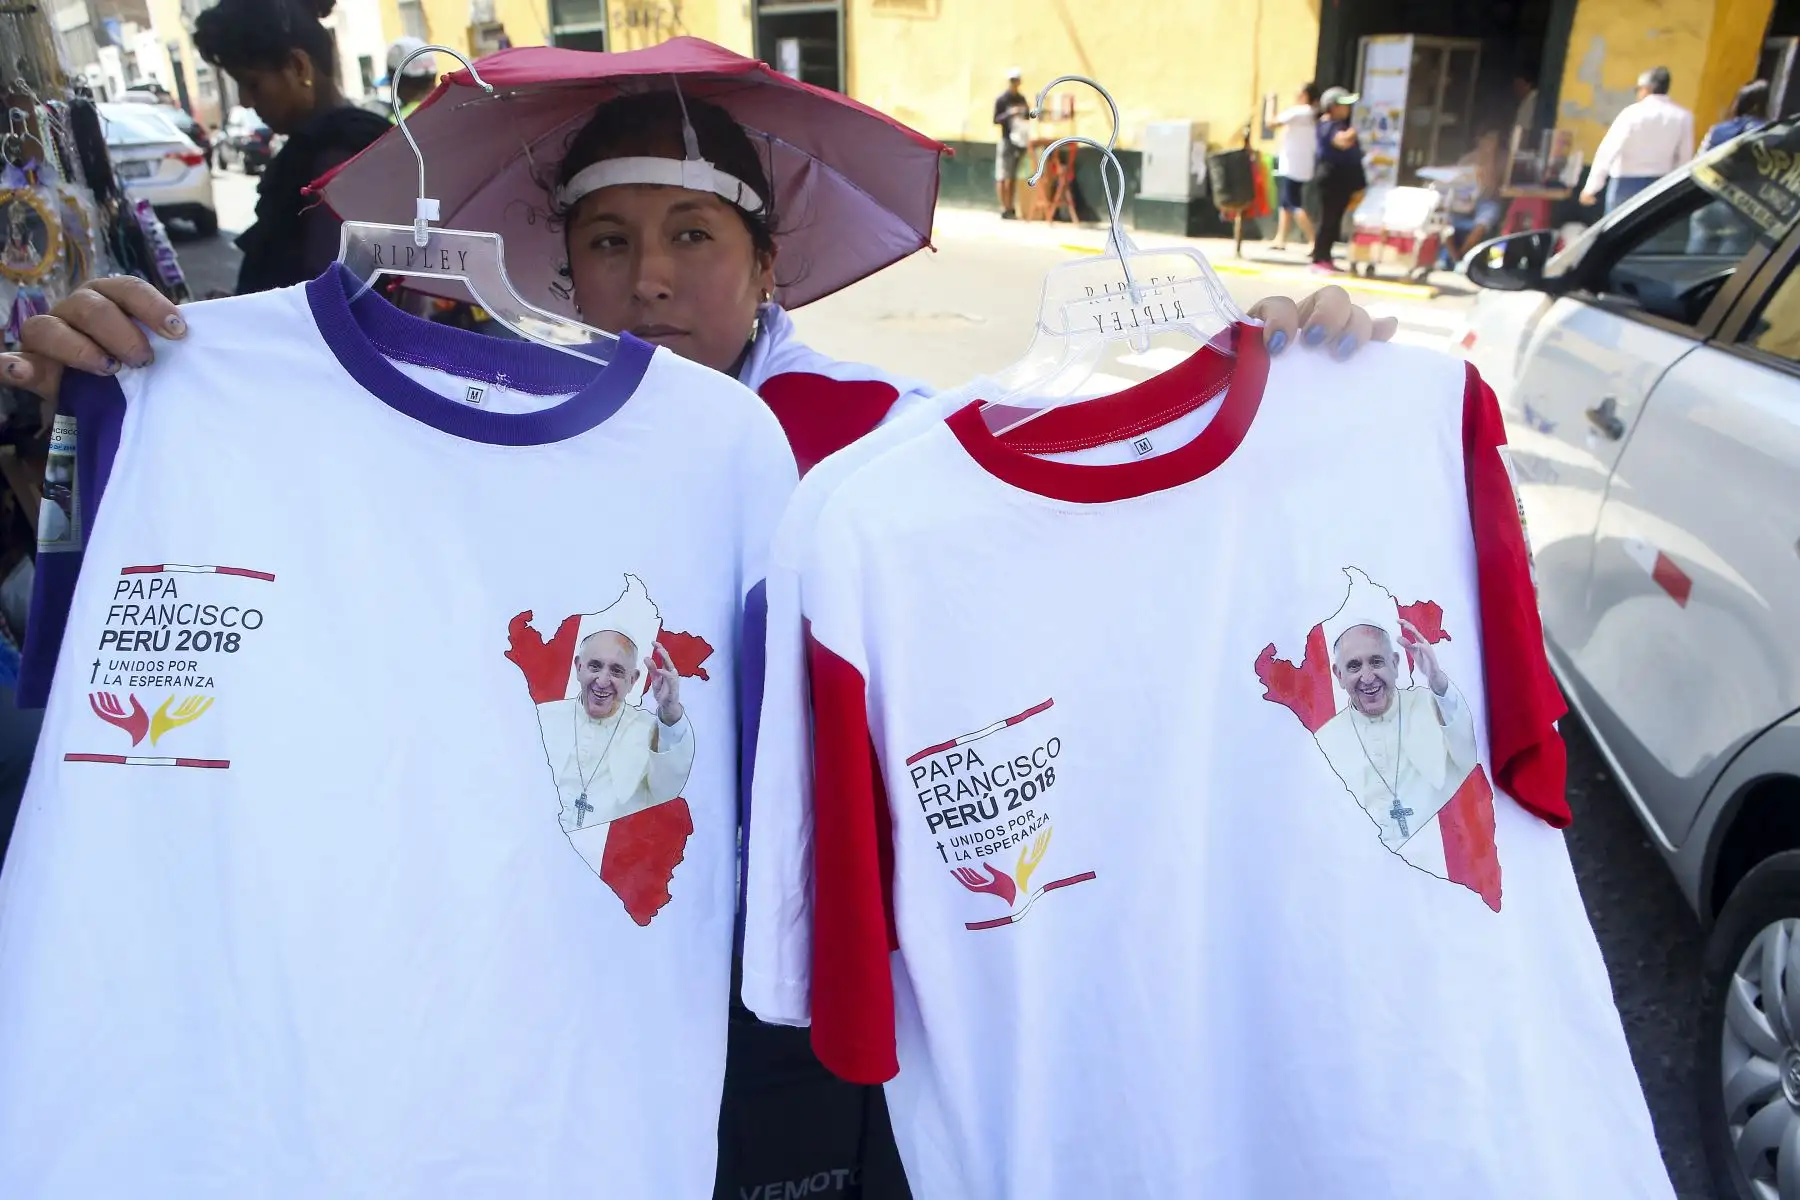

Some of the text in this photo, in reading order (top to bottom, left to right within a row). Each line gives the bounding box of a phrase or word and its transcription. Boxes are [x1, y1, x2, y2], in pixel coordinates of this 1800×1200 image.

[373, 243, 467, 272] RIPLEY
[114, 577, 179, 601] PAPA
[105, 603, 264, 630] FRANCISCO
[98, 624, 242, 654] PERÚ 2018
[103, 674, 215, 688] LA ESPERANZA
[108, 660, 198, 672] UNIDOS POR
[910, 748, 985, 789] PAPA
[918, 736, 1062, 812] FRANCISCO
[925, 766, 1057, 835] PERÚ 2018
[950, 809, 1036, 848] UNIDOS POR
[955, 812, 1050, 862] LA ESPERANZA
